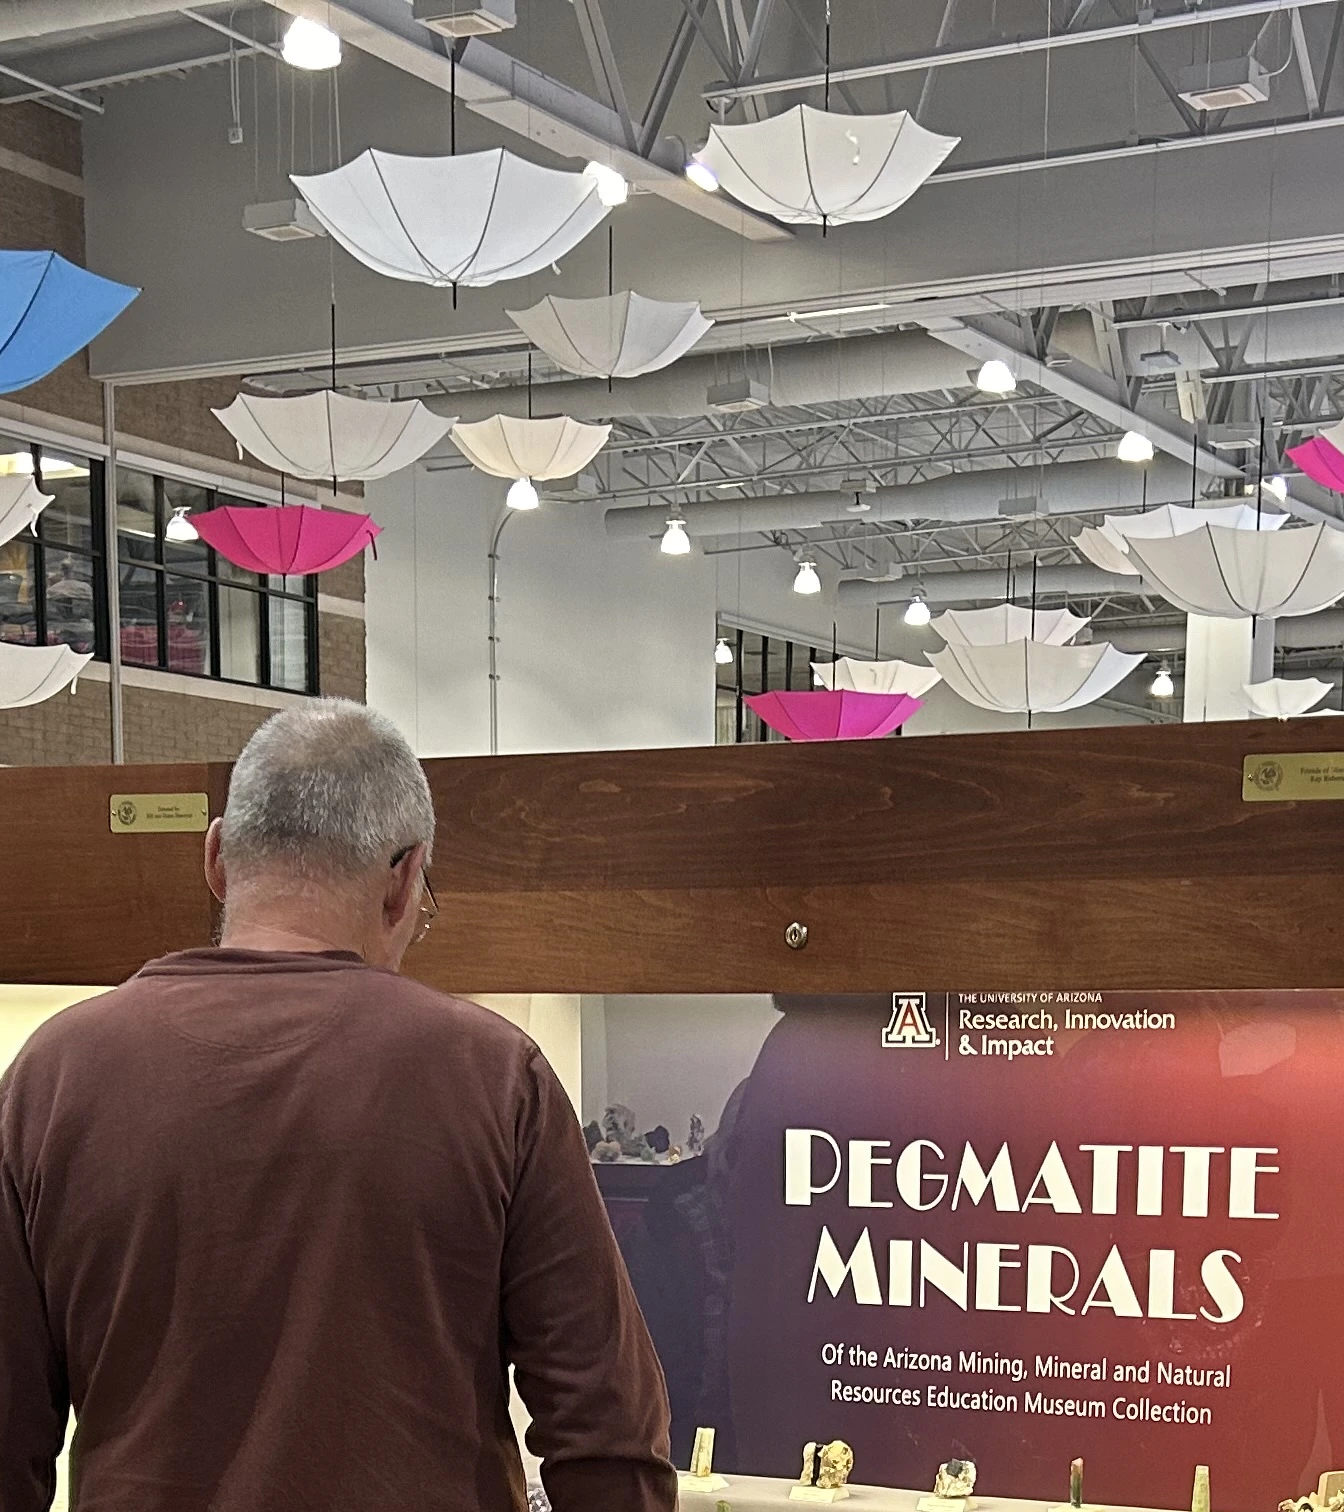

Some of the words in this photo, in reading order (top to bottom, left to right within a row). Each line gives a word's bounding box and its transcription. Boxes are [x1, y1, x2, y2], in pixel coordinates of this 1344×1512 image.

[958, 992, 978, 1004] THE
[980, 992, 1037, 1004] UNIVERSITY
[1039, 992, 1054, 1004] OF
[1056, 992, 1103, 1004] ARIZONA
[958, 1009, 1058, 1032] Research,
[1065, 1009, 1176, 1030] Innovation
[958, 1034, 978, 1056] &
[981, 1034, 1054, 1060] Impact
[785, 1128, 1280, 1219] PEGMATITE
[807, 1225, 1245, 1324] MINERALS
[822, 1343, 844, 1365] Of
[849, 1345, 878, 1367] the
[883, 1347, 952, 1372] Arizona
[958, 1351, 1028, 1382] Mining,
[1035, 1355, 1107, 1381] Mineral
[1113, 1360, 1150, 1384] and
[1157, 1361, 1231, 1387] Natural
[831, 1380, 921, 1406] Resources
[927, 1385, 1018, 1412] Education
[1024, 1391, 1106, 1418] Museum
[1113, 1397, 1212, 1425] Collection
